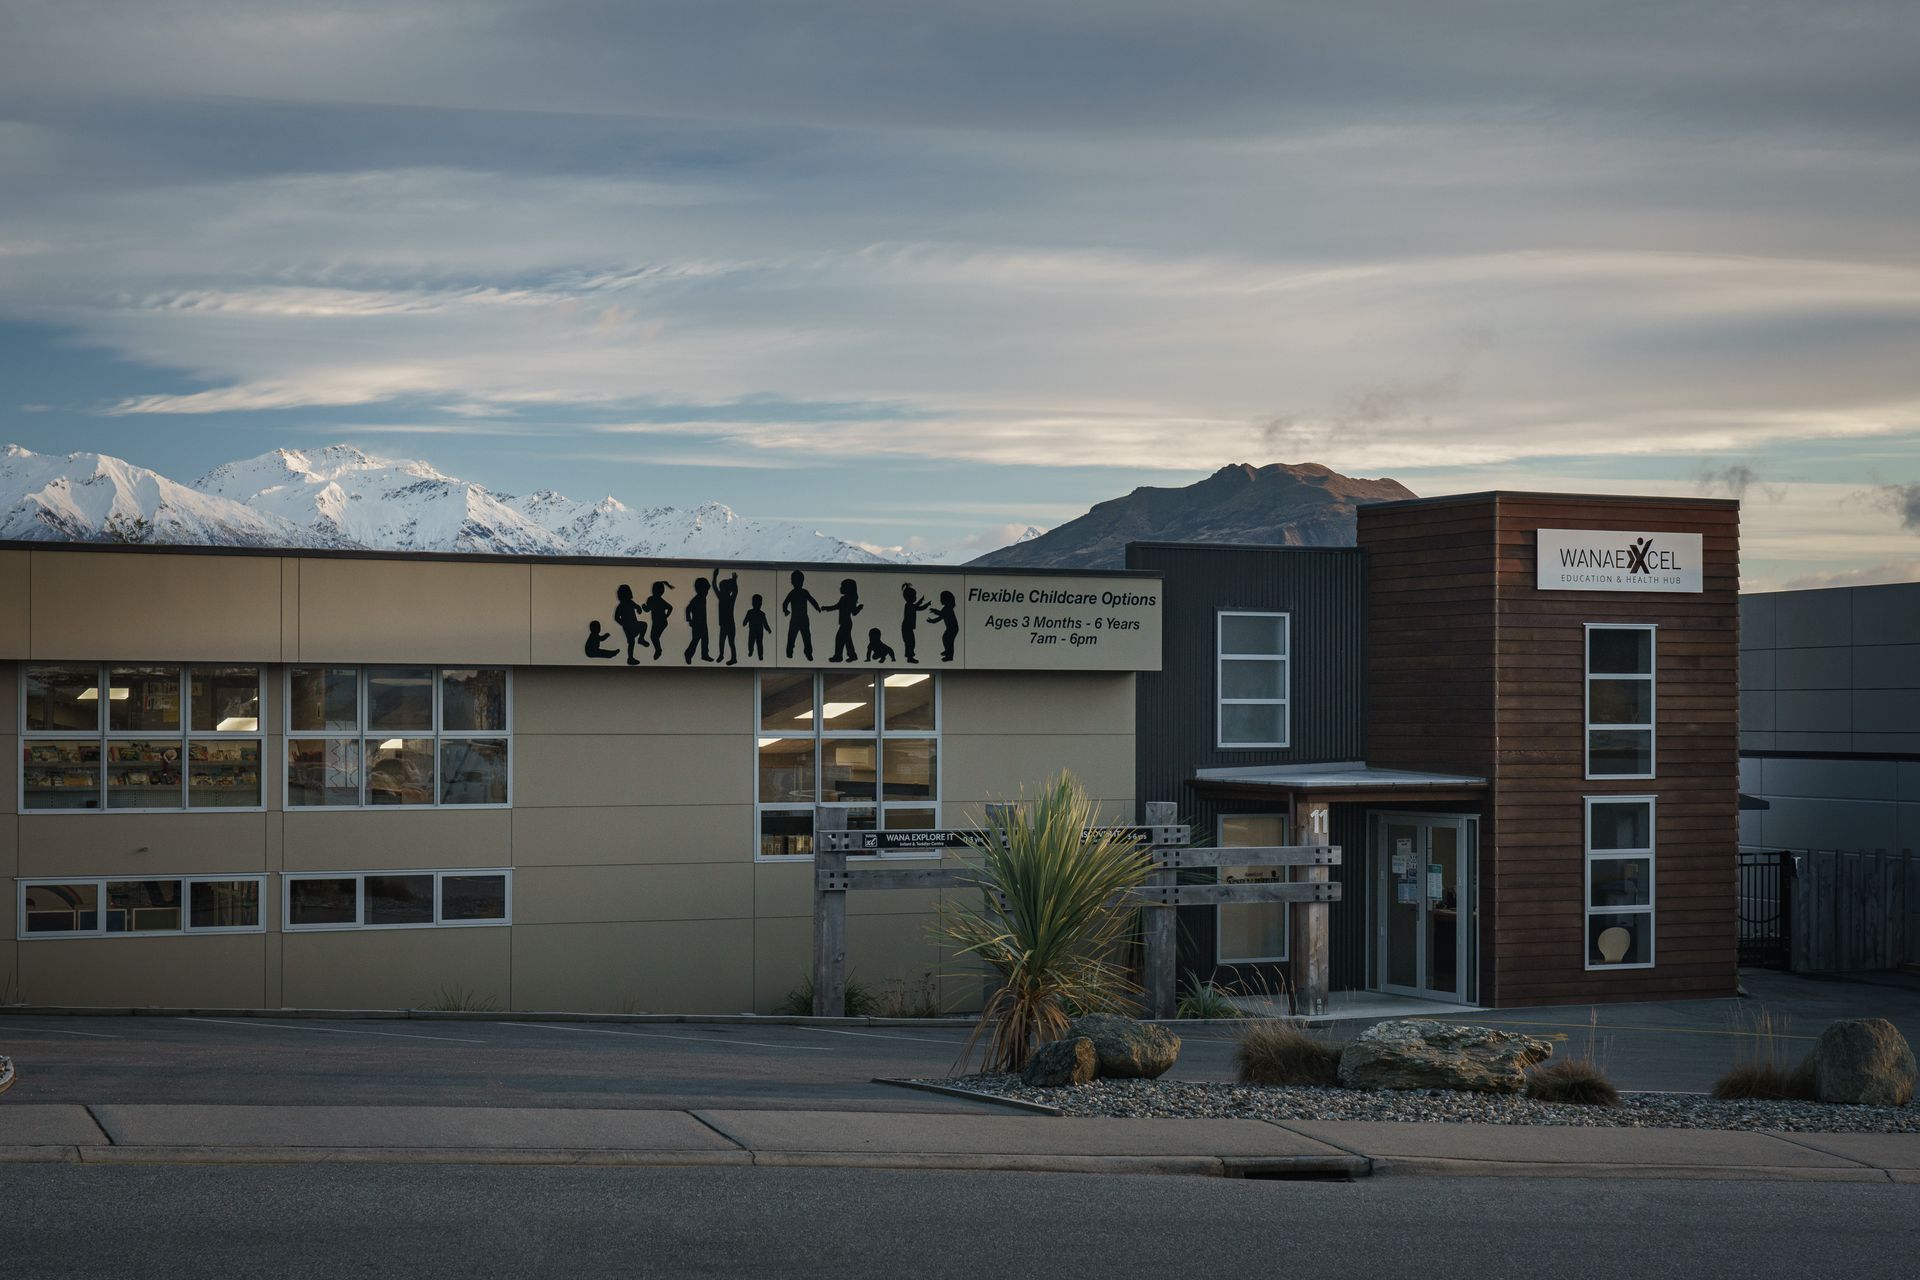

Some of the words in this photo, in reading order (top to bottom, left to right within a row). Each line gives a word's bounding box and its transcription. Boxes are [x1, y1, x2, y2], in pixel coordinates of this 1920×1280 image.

[1561, 574, 1612, 583] EDUCATION
[1616, 575, 1622, 583] &
[1626, 576, 1659, 584] HEALTH
[1663, 576, 1681, 585] HUB
[968, 588, 1024, 603] Flexible
[1029, 589, 1097, 605] Childcare
[1101, 591, 1157, 608] Options
[985, 615, 1018, 630] Ages
[1022, 616, 1030, 628] 3
[1033, 616, 1082, 629] Months
[1094, 617, 1103, 629] 6
[1106, 617, 1140, 630] Years
[1030, 632, 1057, 645] 7am
[1069, 632, 1097, 647] 6pm
[1310, 809, 1328, 834] 11
[886, 833, 910, 842] WANA
[911, 833, 946, 841] EXPLORE
[946, 833, 953, 841] IT
